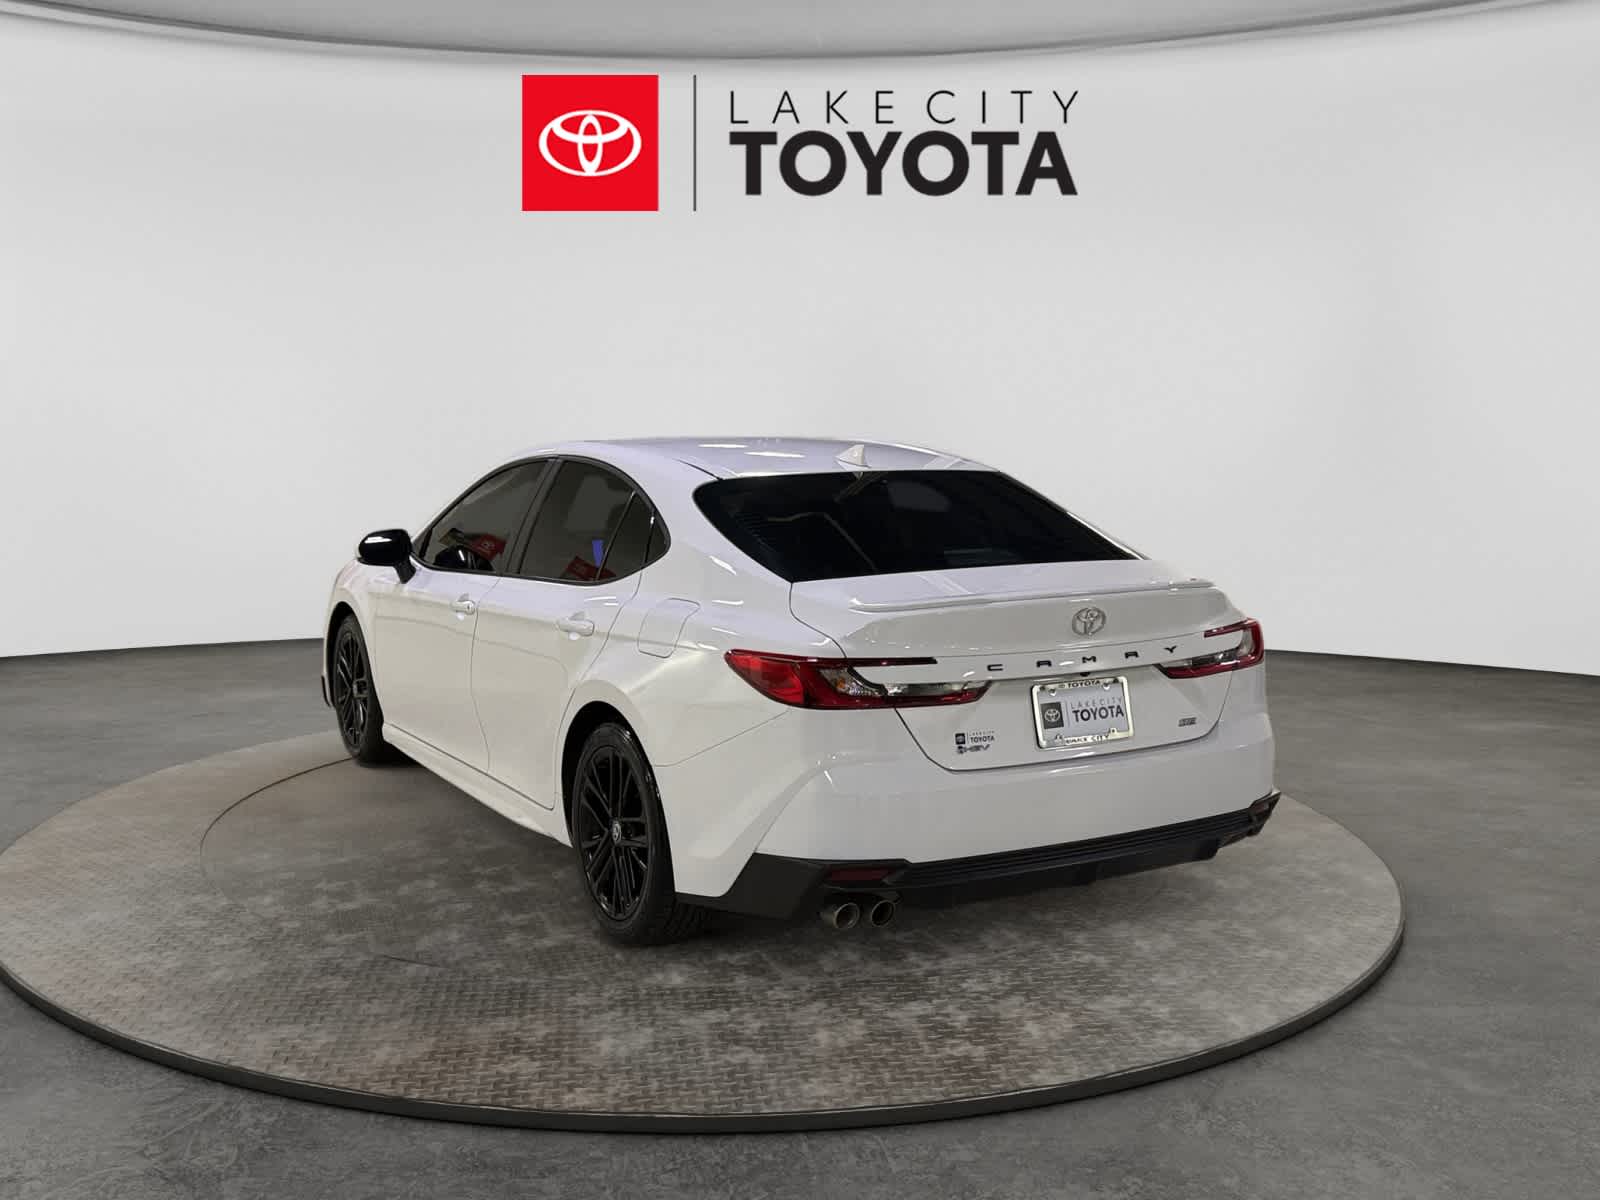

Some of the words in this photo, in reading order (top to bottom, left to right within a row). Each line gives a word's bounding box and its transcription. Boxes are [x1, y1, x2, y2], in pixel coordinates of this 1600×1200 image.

[987, 646, 1177, 671] CAMRY
[1067, 679, 1100, 689] TOYOTA
[1070, 700, 1096, 709] LAKE
[1099, 697, 1122, 706] CITY
[1072, 704, 1125, 722] TOYOTA
[970, 735, 995, 744] TOYOTA
[1090, 734, 1110, 742] CITY
